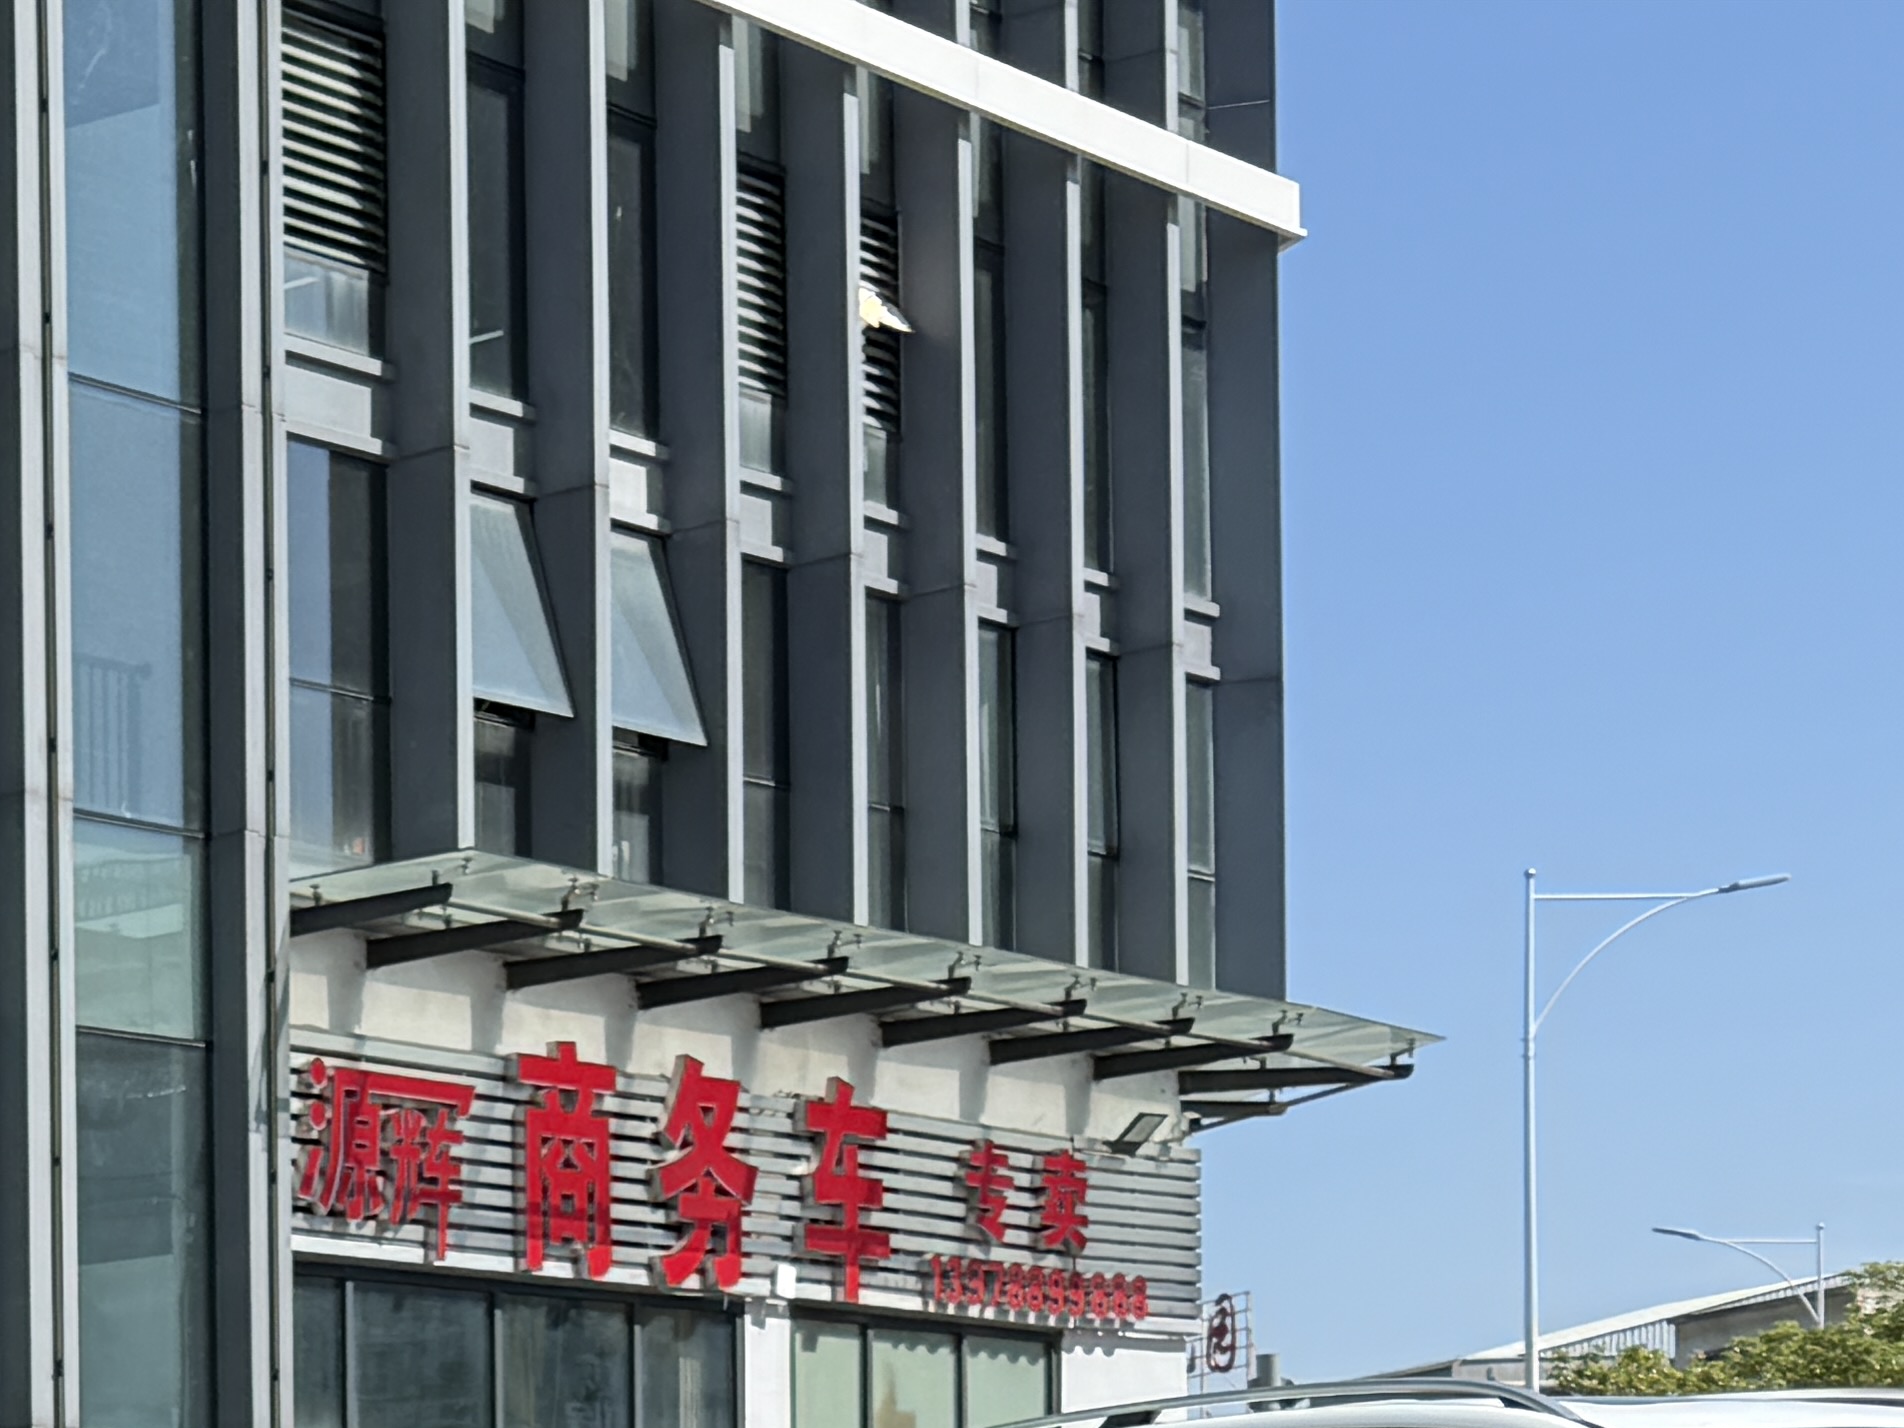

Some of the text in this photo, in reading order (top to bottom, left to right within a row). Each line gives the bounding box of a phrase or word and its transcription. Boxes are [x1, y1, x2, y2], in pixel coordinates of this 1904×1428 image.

[509, 1040, 891, 1304] 商务车
[960, 1138, 1089, 1251] 专卖
